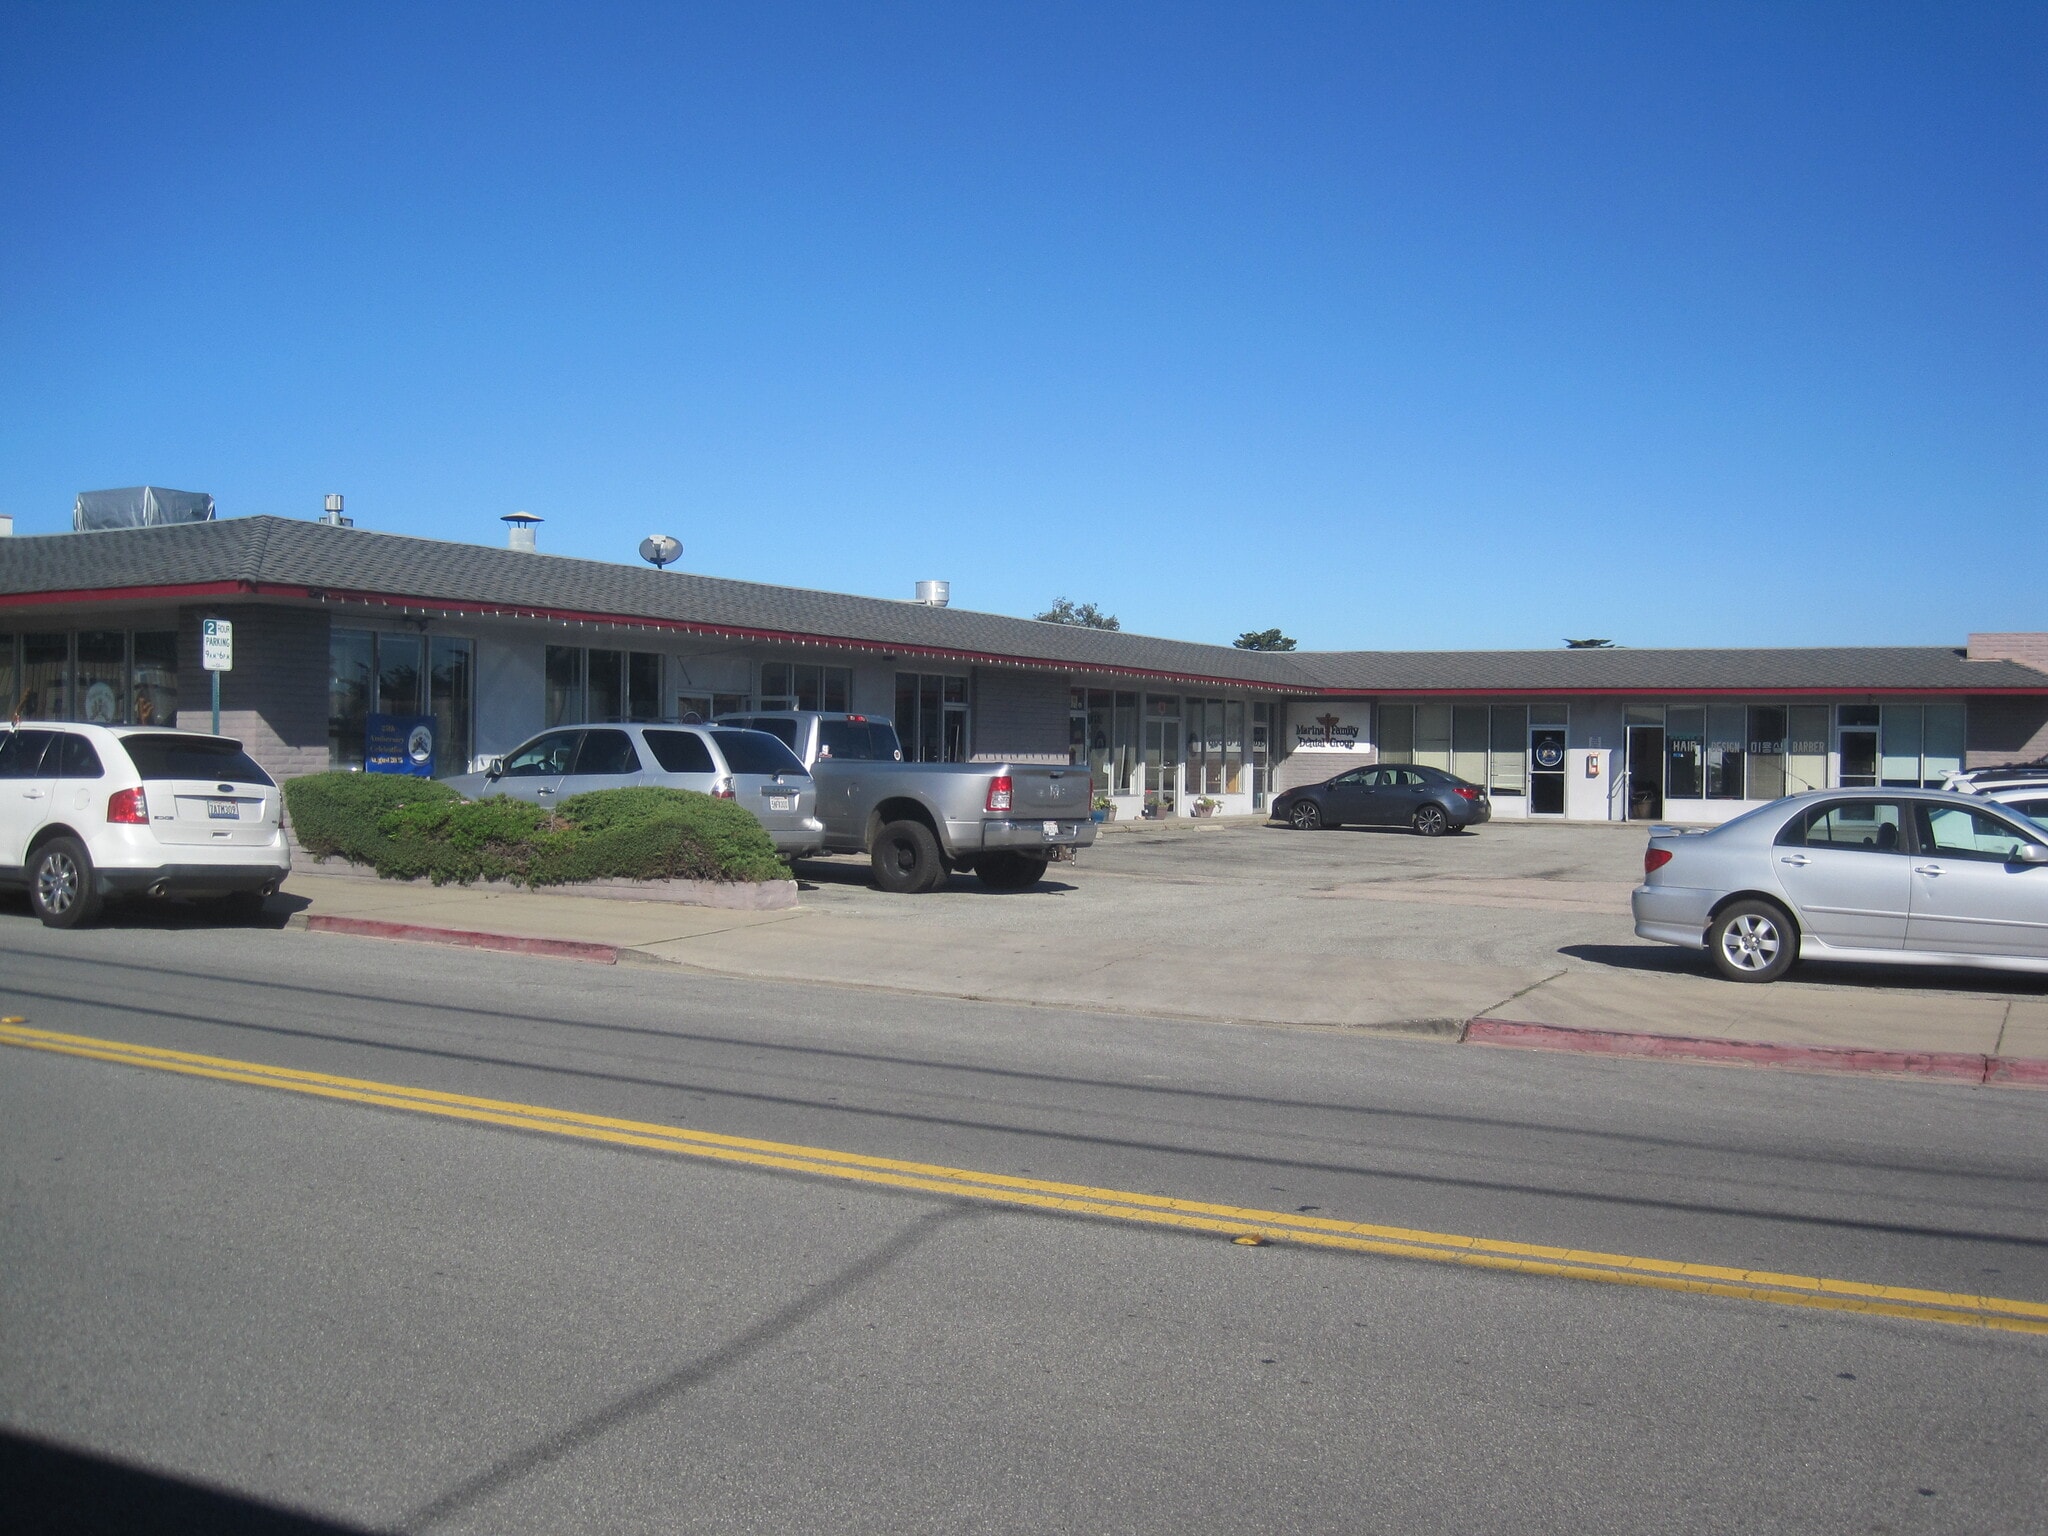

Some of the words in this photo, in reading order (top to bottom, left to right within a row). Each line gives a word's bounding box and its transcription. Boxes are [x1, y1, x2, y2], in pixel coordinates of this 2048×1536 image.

[207, 622, 215, 635] 2
[217, 624, 230, 634] HOUR
[205, 636, 230, 648] PARKING
[1296, 724, 1325, 736] Marina
[1331, 725, 1360, 738] Family
[1297, 736, 1326, 748] Dental
[1330, 738, 1356, 750] Group
[1673, 740, 1698, 752] HAIR
[1711, 741, 1740, 753] DESIGN
[1750, 741, 1783, 754] 미용실
[1792, 741, 1825, 753] BARBER
